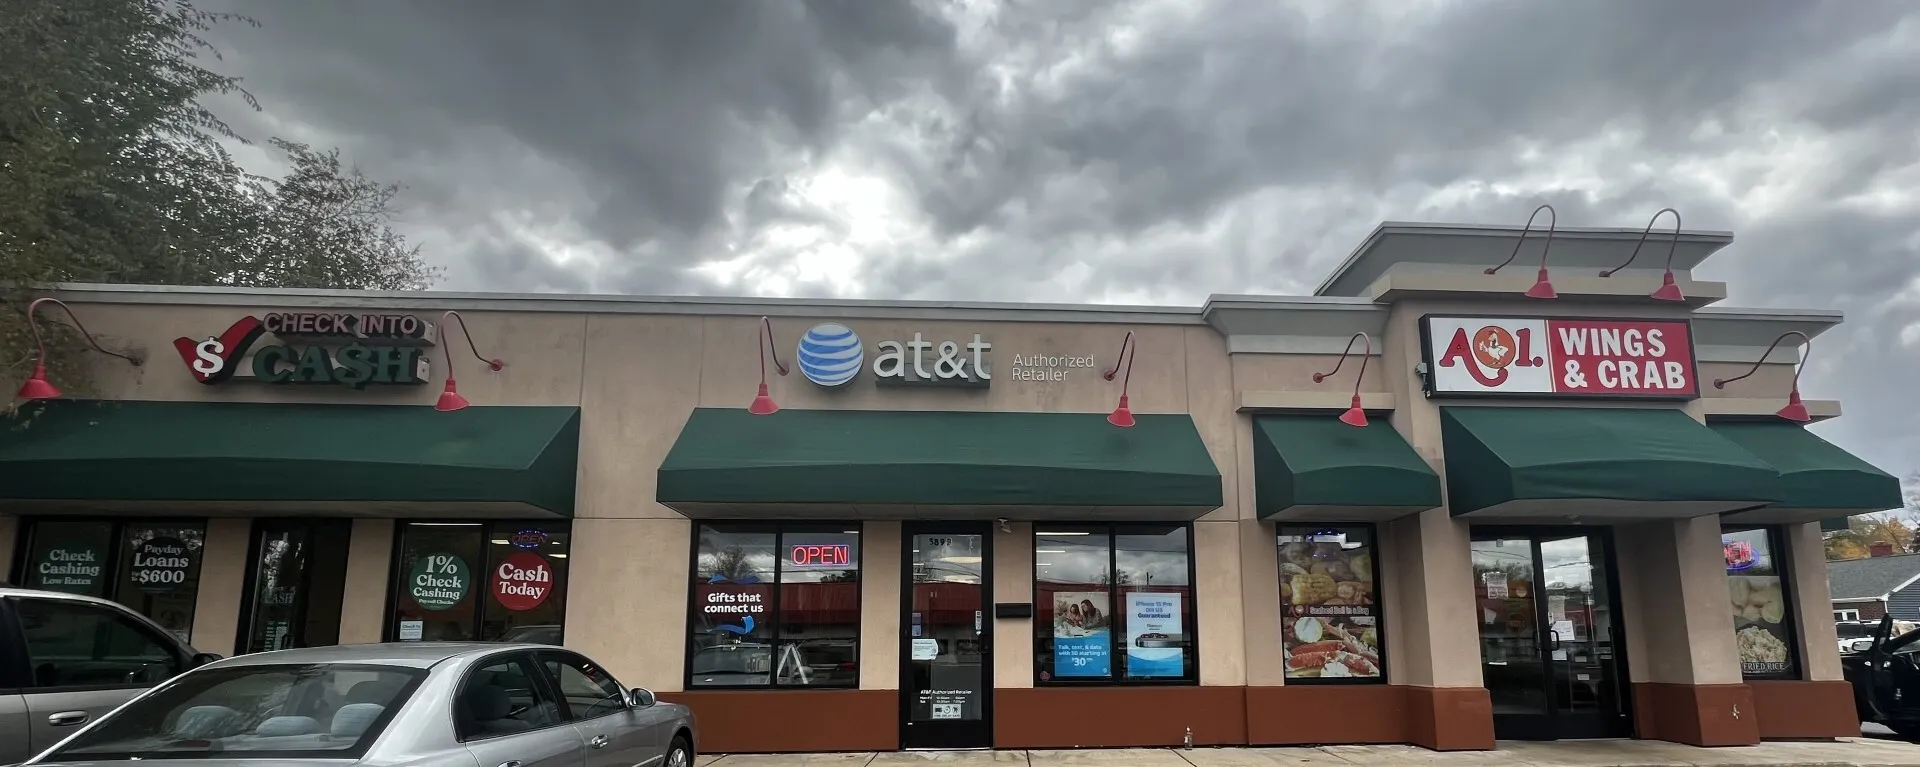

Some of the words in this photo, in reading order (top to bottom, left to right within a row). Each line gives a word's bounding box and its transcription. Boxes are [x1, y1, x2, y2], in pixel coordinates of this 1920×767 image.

[263, 313, 350, 333] CHECK
[359, 314, 419, 334] INTO
[1558, 327, 1666, 358] WINGS
[1012, 353, 1095, 367] Authorized
[1012, 367, 1069, 381] Retailer
[1564, 359, 1588, 388] &
[1597, 359, 1686, 390] CRAB
[49, 549, 96, 562] Check
[144, 544, 184, 556] Payday
[793, 546, 847, 564] OPEN
[133, 552, 189, 568] Loans
[426, 555, 458, 574] 1%
[39, 562, 100, 577] Cashing
[139, 569, 185, 584] $600
[498, 563, 549, 582] Cash
[42, 576, 62, 585] Low
[64, 576, 92, 585] Rates
[416, 574, 462, 588] Check
[413, 587, 460, 600] Cashing
[499, 581, 545, 600] Today
[707, 592, 735, 603] Gifts
[737, 593, 761, 603] that
[704, 603, 748, 613] connect
[750, 604, 764, 613] us
[1743, 662, 1766, 671] FRIED
[1767, 662, 1785, 671] RICE
